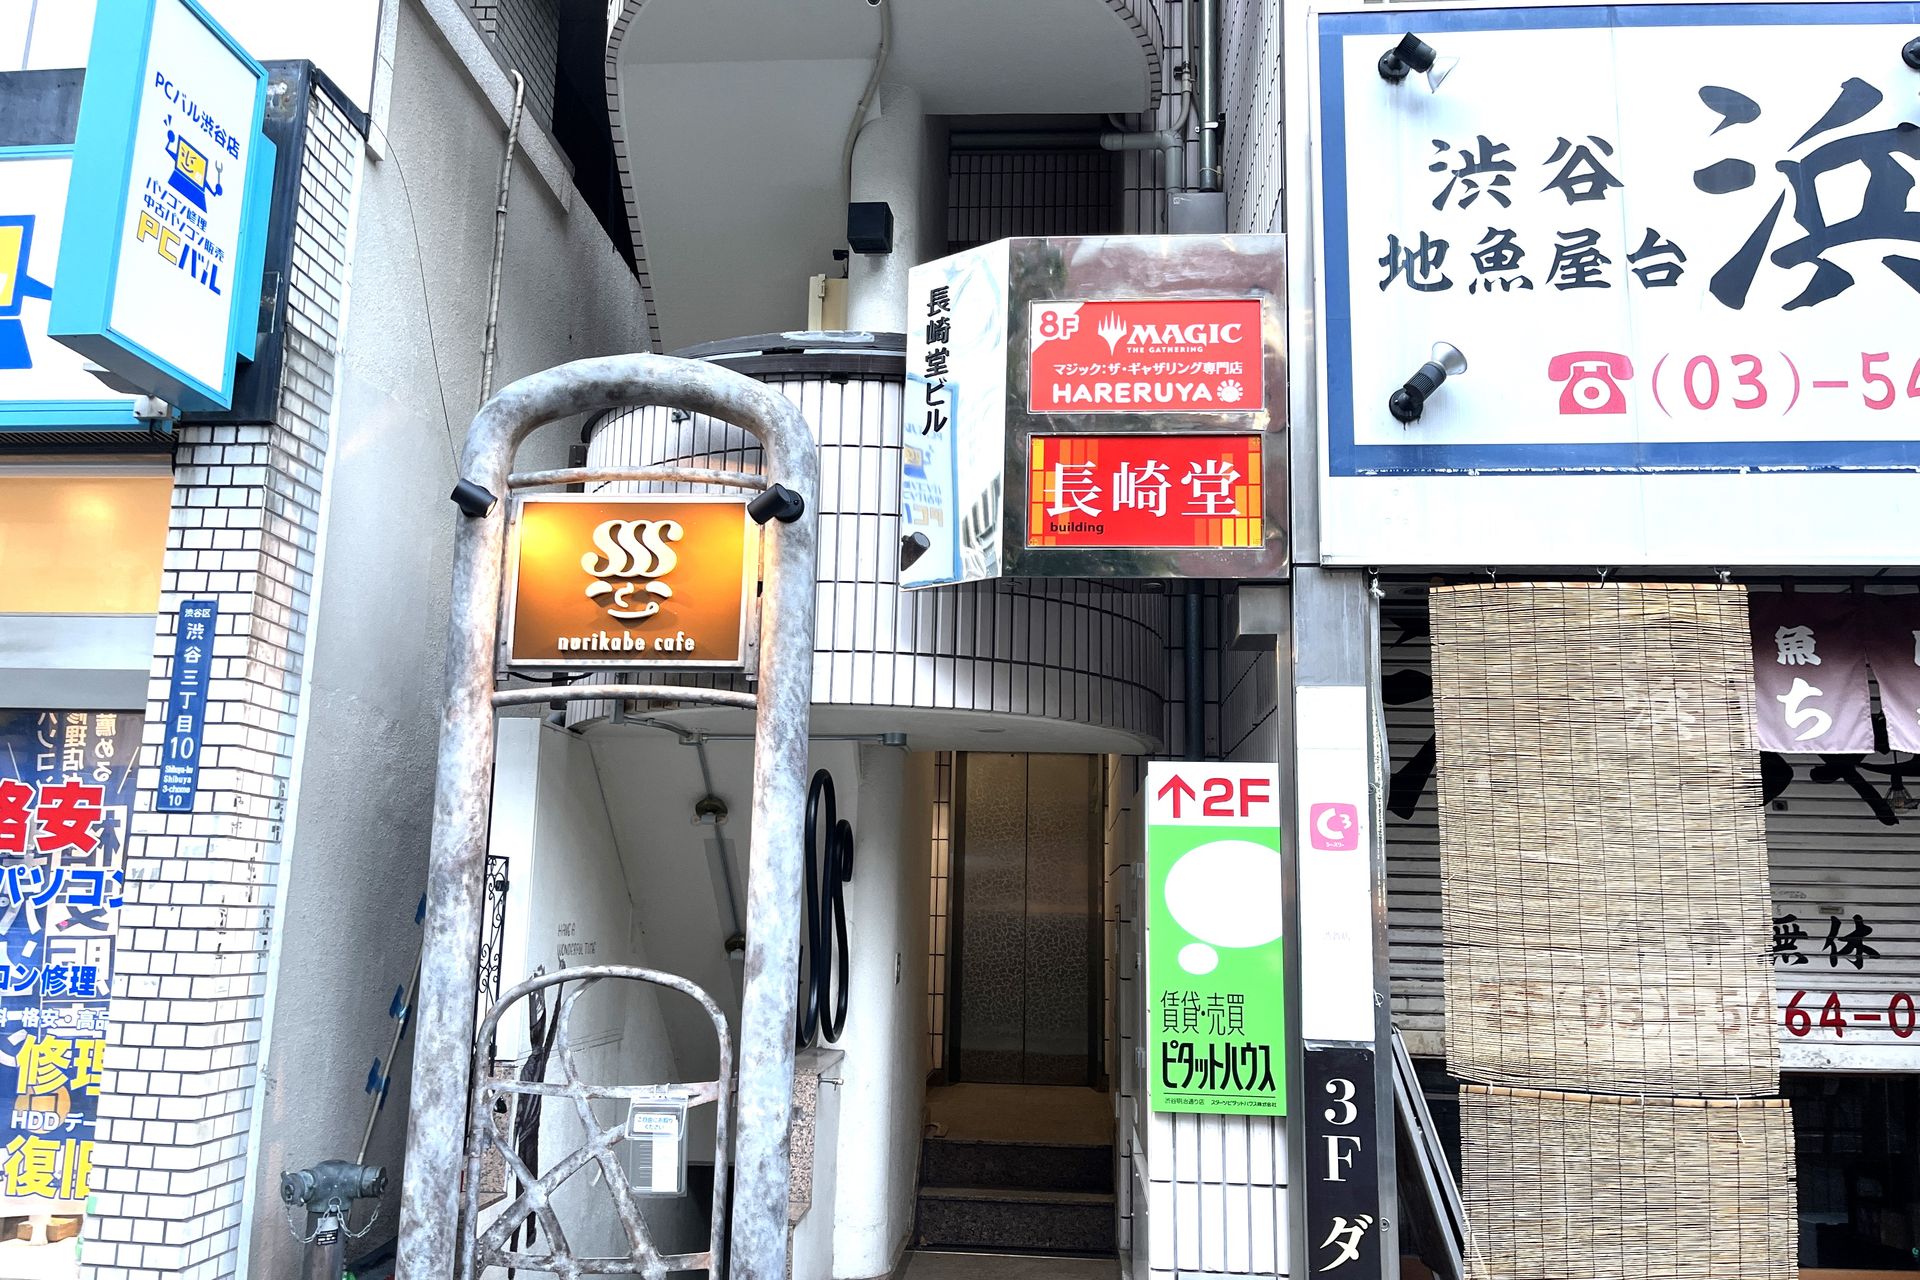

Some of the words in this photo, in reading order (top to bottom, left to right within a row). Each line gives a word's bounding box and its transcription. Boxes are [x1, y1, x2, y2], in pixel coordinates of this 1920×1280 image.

[155, 71, 240, 160] PCバル渋谷店
[1428, 134, 1625, 211] 渋谷
[146, 176, 208, 232] パソコン修理
[144, 193, 225, 263] 中古パソコン販売
[136, 209, 222, 296] PCバル
[1378, 227, 1688, 294] 地魚屋台
[1039, 310, 1080, 341] 8F
[1126, 323, 1244, 347] MAGIC
[921, 285, 951, 436] 長崎堂ビル
[1126, 346, 1145, 354] THE
[1149, 346, 1204, 354] GATHERING
[1052, 382, 1214, 405] HARERUYA
[1043, 459, 1243, 519] 長崎堂
[1050, 522, 1104, 535] building
[184, 608, 212, 618] 渋谷区
[557, 630, 646, 651] nurikabe
[654, 631, 696, 651] cafe
[162, 784, 191, 793] 3-chome
[163, 774, 192, 785] Shibuya
[1203, 777, 1270, 817] 2F
[168, 795, 183, 806] 10
[1161, 990, 1245, 1036] 賃貸・売買
[1162, 1040, 1277, 1092] ピタットハウス
